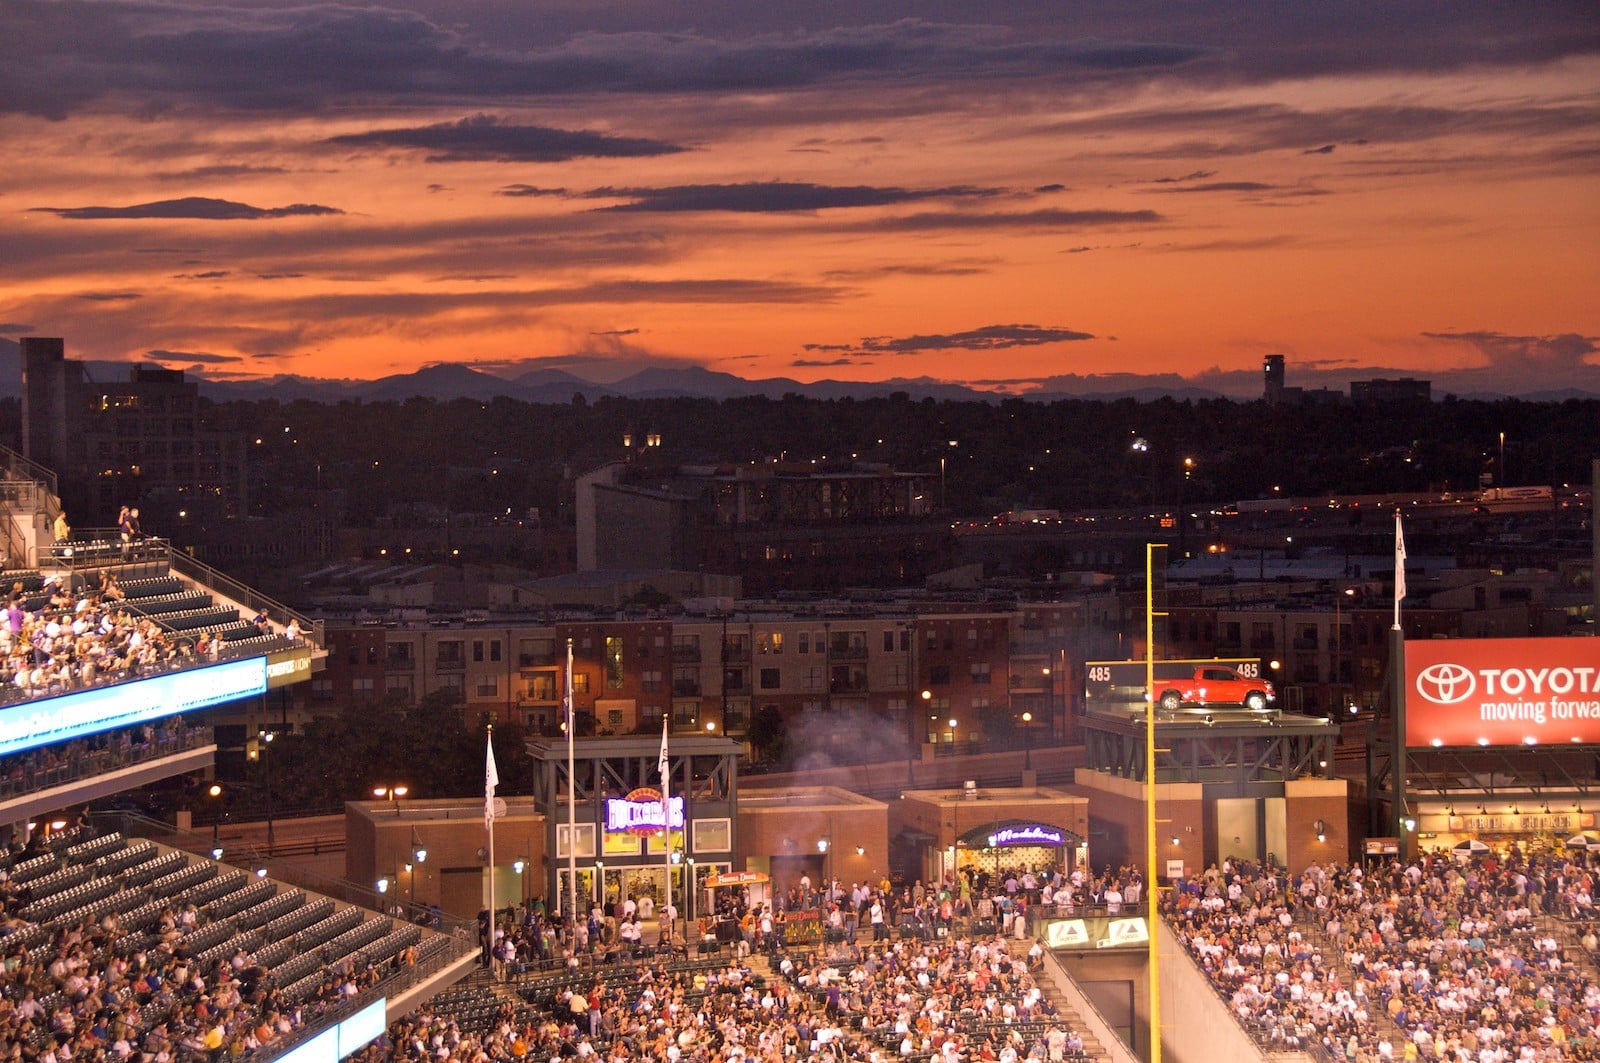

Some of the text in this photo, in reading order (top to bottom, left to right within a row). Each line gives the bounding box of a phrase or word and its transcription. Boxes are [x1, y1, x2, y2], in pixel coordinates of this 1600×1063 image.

[1088, 667, 1111, 682] 485
[1237, 663, 1258, 678] 485
[1480, 697, 1547, 724] moving
